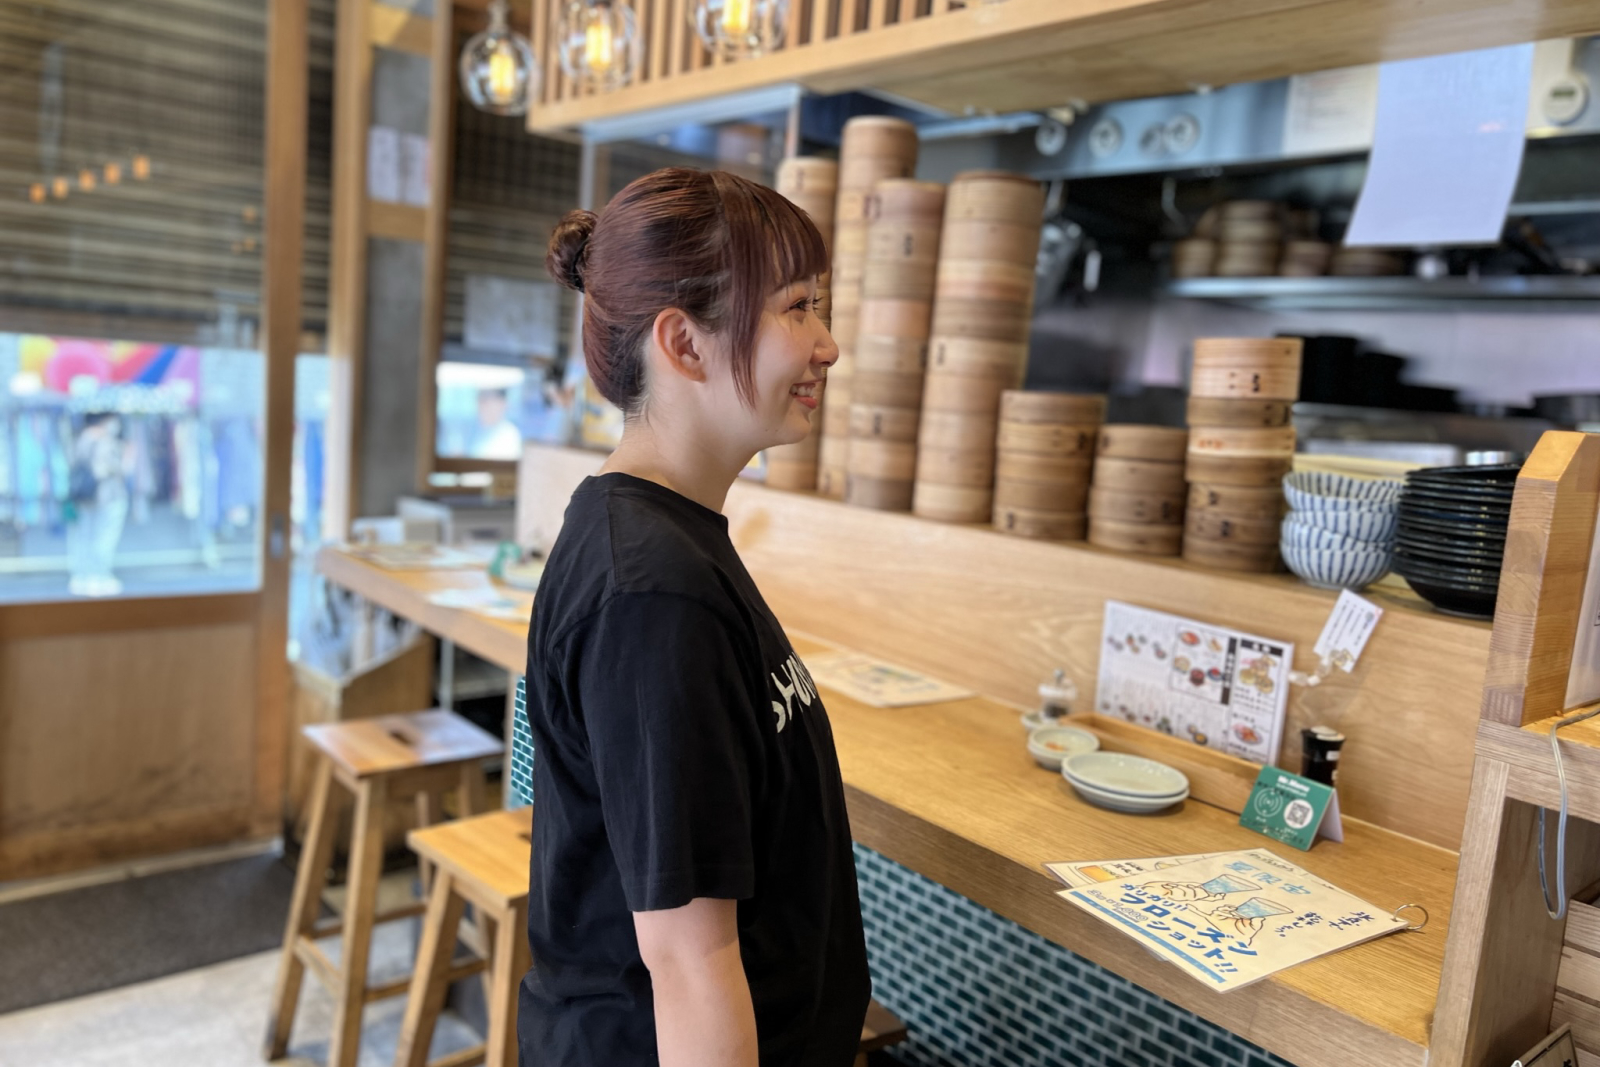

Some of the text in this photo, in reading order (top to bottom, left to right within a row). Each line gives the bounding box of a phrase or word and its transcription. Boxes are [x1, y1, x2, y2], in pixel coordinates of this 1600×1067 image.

[1120, 883, 1188, 912] ガリガリ!!
[1120, 892, 1258, 956] フローズン
[1146, 919, 1239, 973] ショット!!
